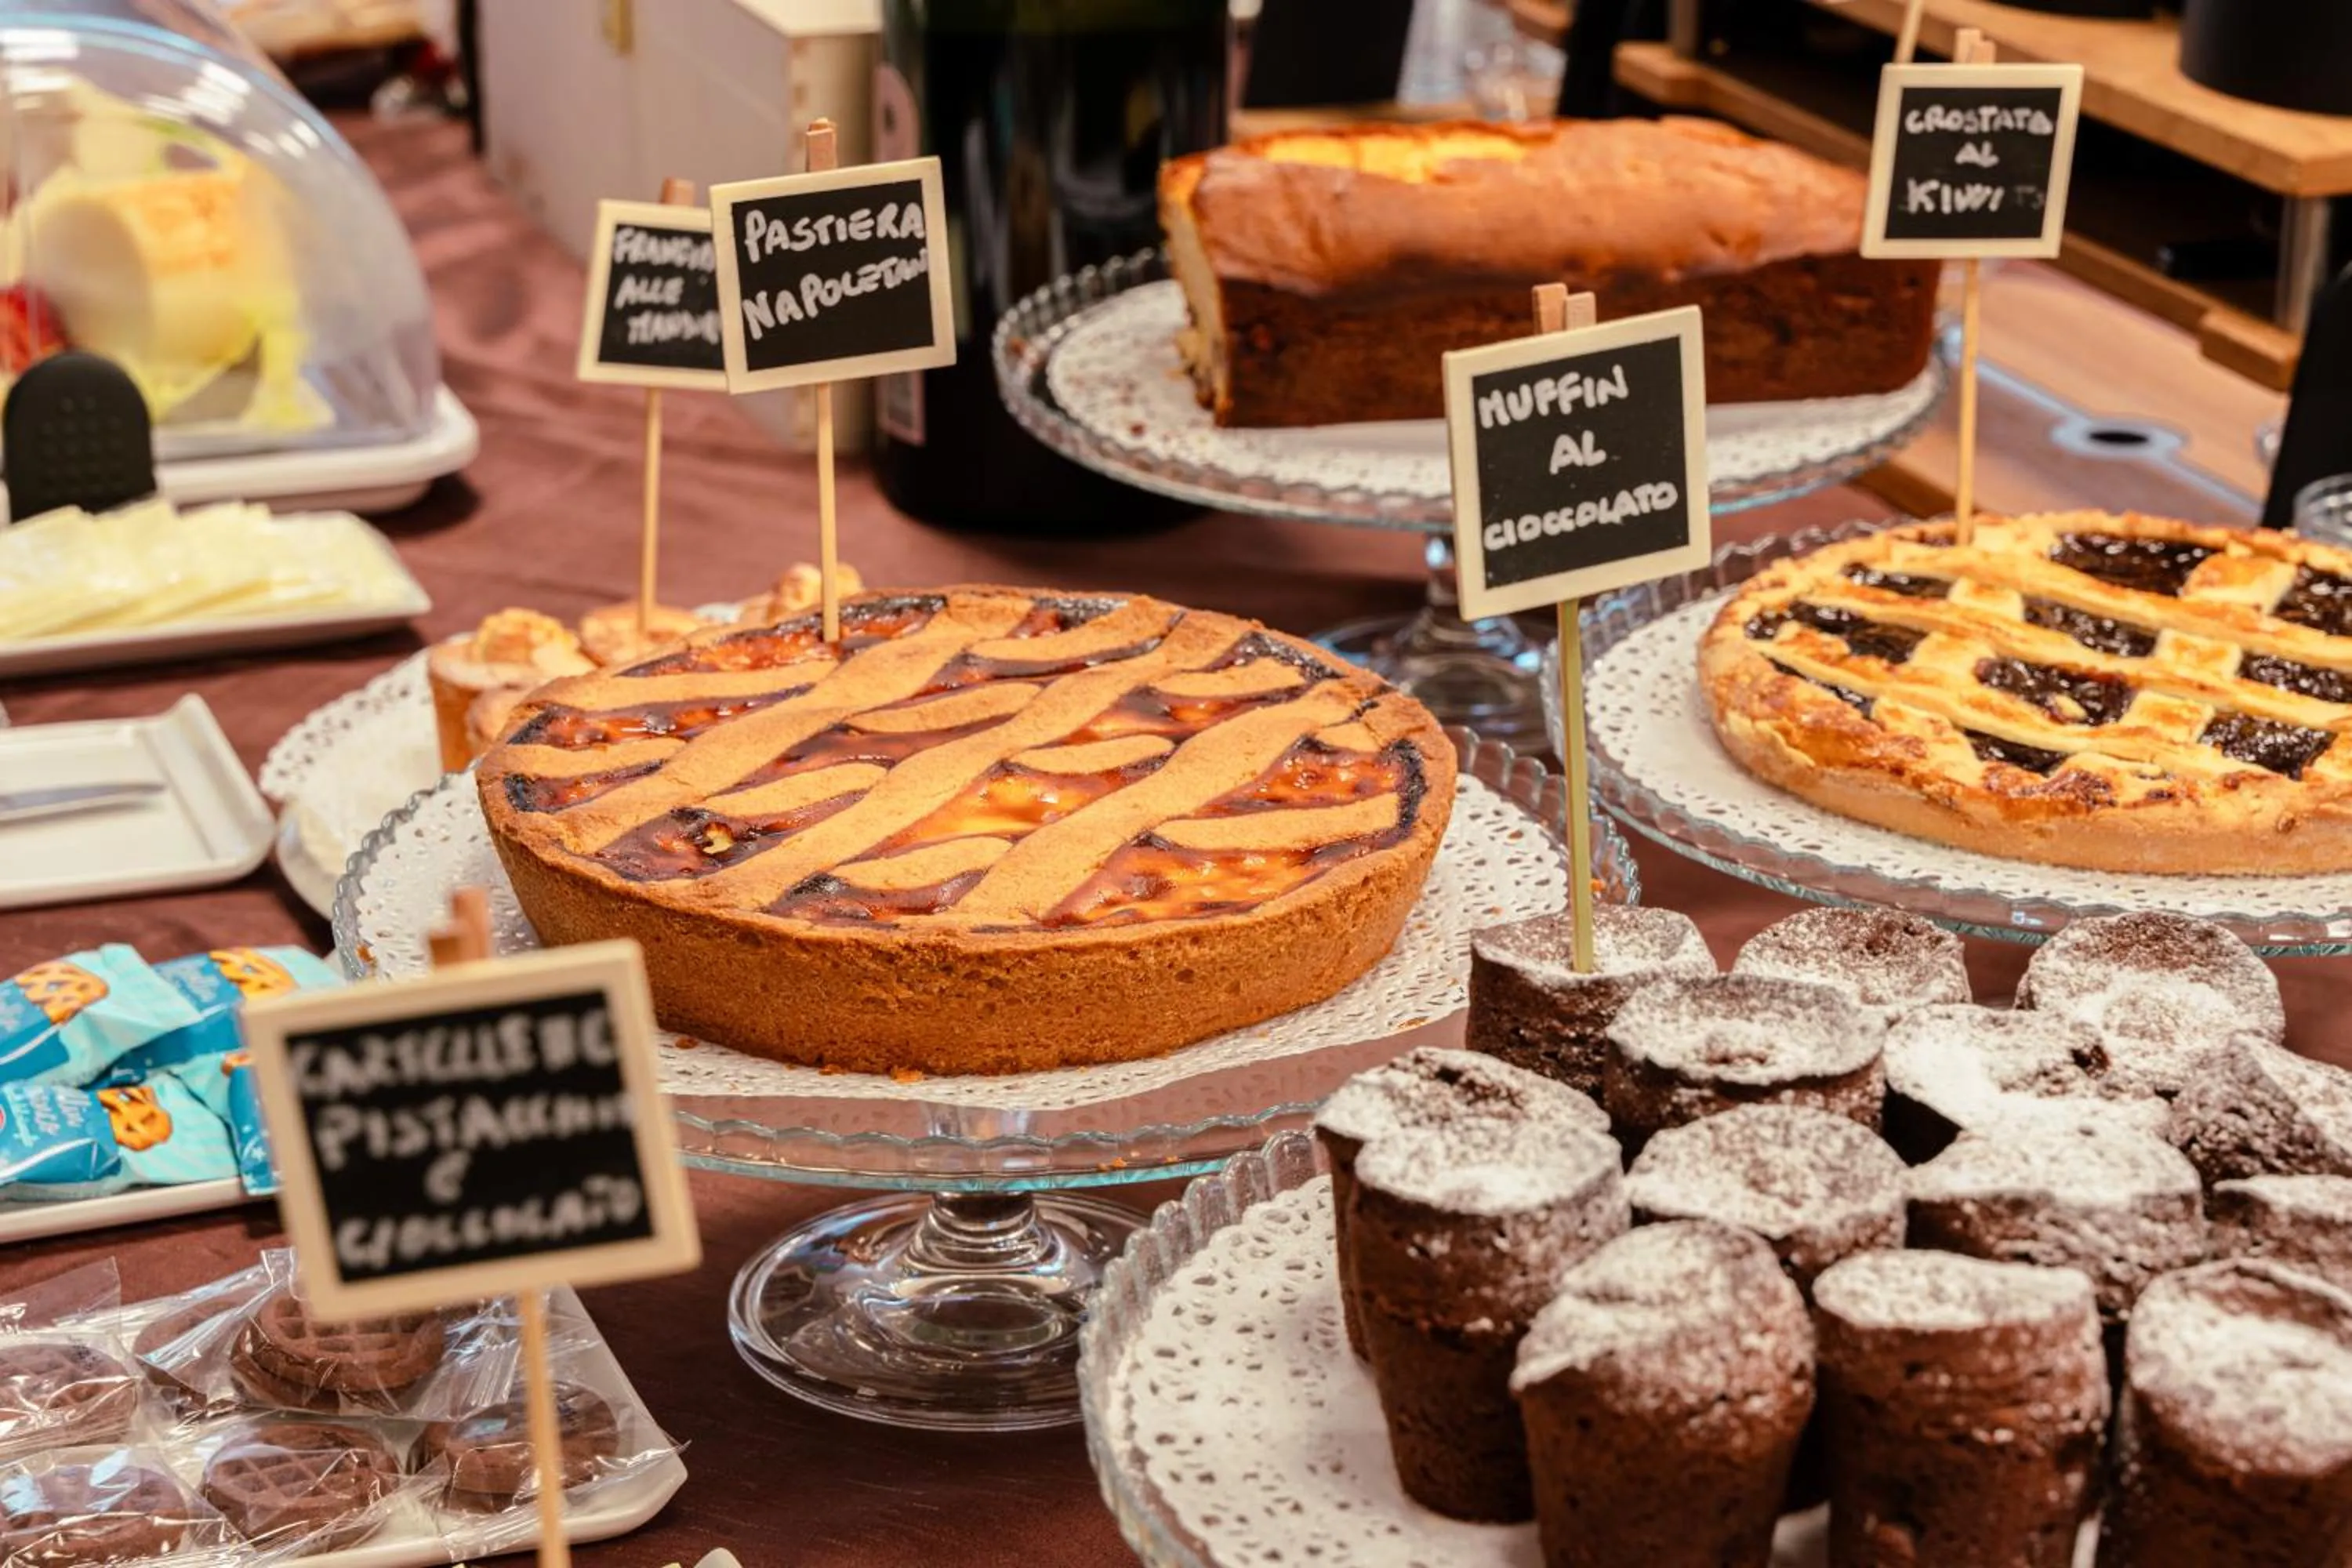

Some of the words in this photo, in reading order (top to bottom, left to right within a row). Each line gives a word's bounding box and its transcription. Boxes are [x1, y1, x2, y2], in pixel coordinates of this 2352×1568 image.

[1904, 103, 2054, 136] CROSTATA
[1954, 141, 1999, 168] AL
[1905, 176, 2005, 215] KIWI
[744, 201, 926, 263] PASTIERA
[614, 273, 685, 310] ALLE
[1477, 363, 1630, 430] MUFFIN
[1548, 429, 1608, 475] AL
[1483, 481, 1679, 551] CIOCCOLATO
